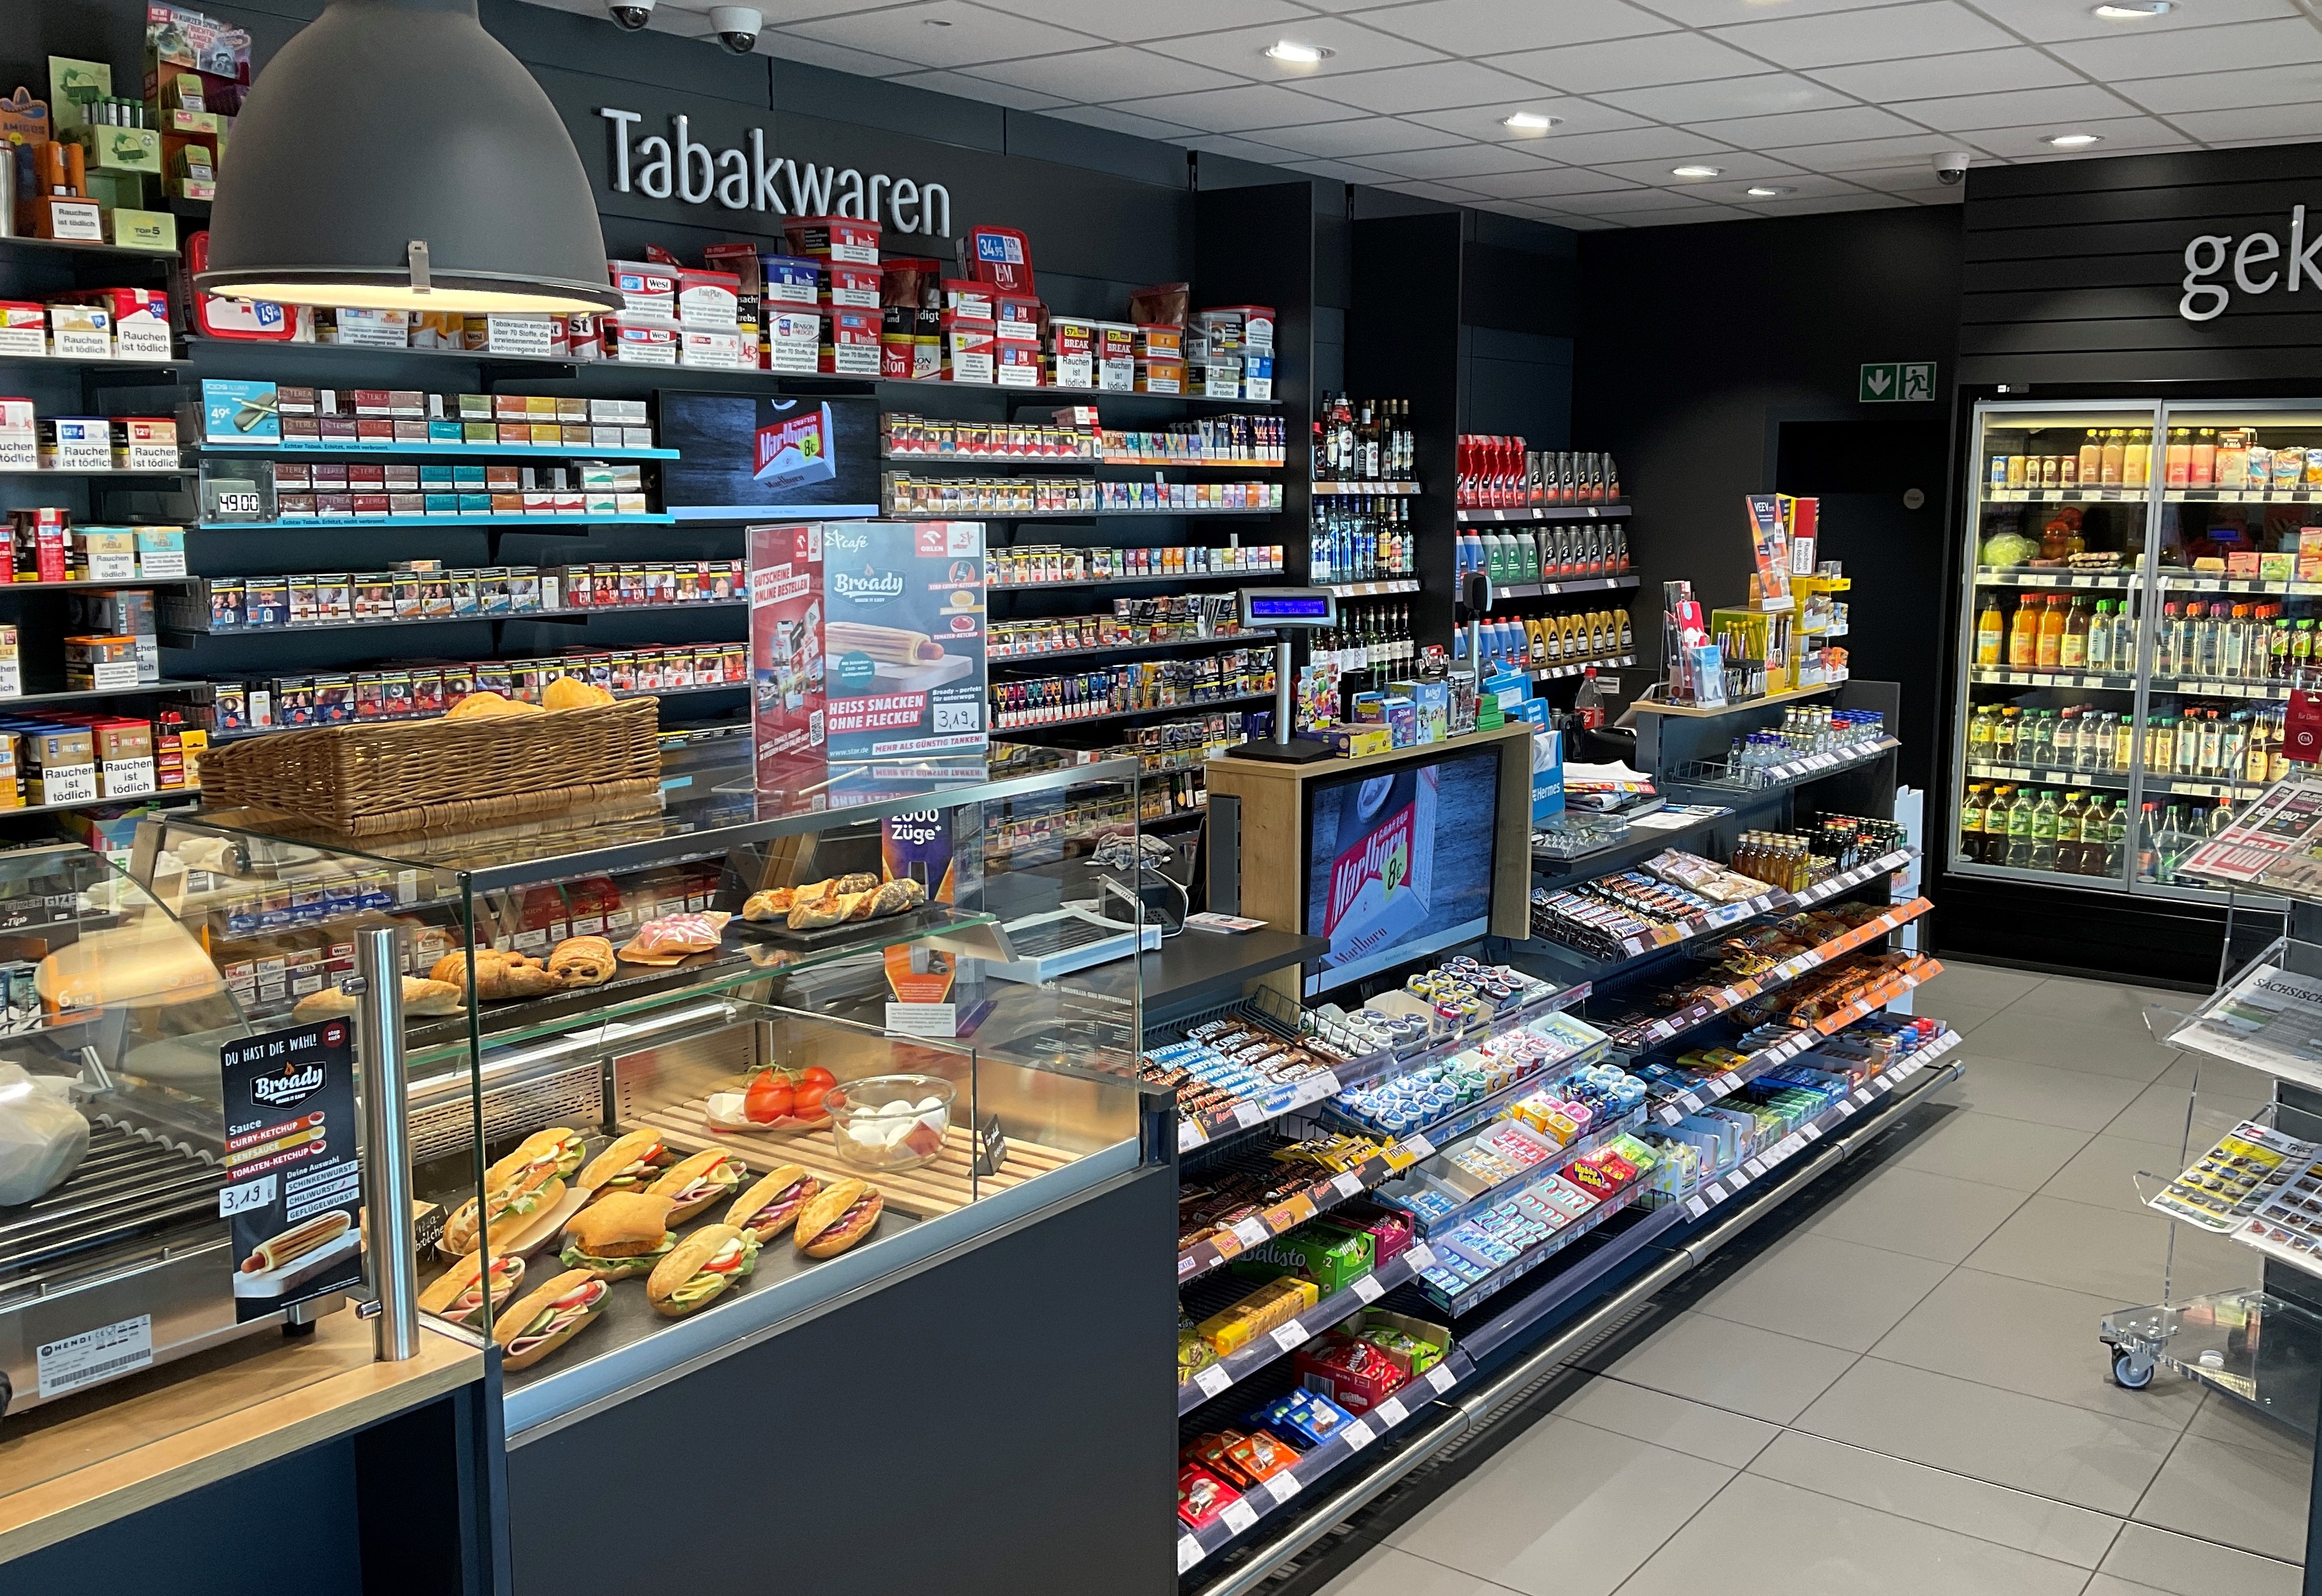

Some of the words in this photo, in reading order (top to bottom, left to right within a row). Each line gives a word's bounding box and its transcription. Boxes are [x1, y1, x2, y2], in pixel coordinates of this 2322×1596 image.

[600, 107, 950, 238] Tabakwaren
[58, 208, 93, 218] Rauchen
[69, 218, 96, 228] tödlich
[134, 227, 151, 235] TOP
[152, 227, 160, 235] 5
[2179, 205, 2322, 321] gek
[649, 279, 669, 289] West
[491, 320, 528, 329] Tabakrauch
[793, 322, 814, 330] BENSON
[63, 336, 103, 345] Rauchen
[123, 331, 166, 341] Rauchen
[651, 331, 669, 340] West
[854, 333, 877, 345] Winston
[63, 345, 74, 353] ist
[76, 345, 105, 354] tödlich
[121, 343, 133, 352] ist
[136, 343, 169, 353] tödlich
[1064, 338, 1089, 350] BREAK
[1107, 343, 1131, 353] BREAK
[882, 360, 905, 373] ston
[1072, 368, 1080, 376] ist
[1065, 378, 1086, 388] tödlich
[1107, 381, 1128, 392] tödlich
[289, 390, 312, 398] TEREA
[760, 422, 818, 466] Marlboro
[65, 447, 110, 456] Rauchen
[135, 447, 176, 457] Rauchen
[62, 458, 75, 467] ist
[77, 458, 111, 467] tödlich
[133, 459, 145, 468] ist
[147, 458, 178, 468] tödlich
[220, 494, 258, 511] 49.00
[1755, 502, 1768, 512] VEEV
[842, 535, 869, 553] café
[1803, 541, 1811, 570] Rauchen
[101, 569, 127, 578] tödlich
[754, 568, 790, 587] GUTSCHEINE
[834, 572, 903, 595] Broady
[755, 586, 776, 603] ONLINE
[778, 578, 808, 597] BESTELLEN
[136, 644, 157, 652] chen
[943, 693, 975, 701] unterwegs
[829, 700, 865, 715] HEISS
[867, 695, 924, 711] SNACKEN
[829, 715, 863, 730] OHNE
[865, 710, 919, 727] FLECKEN
[875, 744, 898, 753] MEHR
[899, 742, 915, 751] ALS
[915, 738, 948, 749] GÜNSTIG
[951, 735, 983, 745] TANKEN!
[829, 747, 869, 756] www.star.de
[105, 760, 153, 772] Rauchen
[46, 767, 94, 779] Rauchen
[124, 772, 138, 781] ist
[65, 779, 79, 788] ist
[113, 782, 150, 793] tödlich
[53, 789, 91, 801] tödlich
[1537, 781, 1561, 801] Hermes
[2276, 810, 2300, 822] 180
[1330, 826, 1407, 929] Marlboro
[1387, 857, 1403, 891] 8€
[5, 897, 43, 912] GIZEH
[44, 894, 77, 907] GIZE
[333, 946, 351, 954] West
[1334, 927, 1387, 964] Marlboro
[58, 989, 70, 1006] 6
[1186, 1019, 1228, 1039] CORNY
[1210, 1030, 1251, 1051] CORNY
[225, 1051, 239, 1067] DU
[242, 1045, 265, 1062] HAST
[269, 1041, 286, 1055] DIE
[289, 1033, 317, 1052] WAHL!
[1143, 1040, 1187, 1059] BOUNTY
[1162, 1048, 1205, 1067] BOUNTY
[1271, 1062, 1310, 1084] CORNY
[255, 1065, 323, 1097] Broady
[1265, 1090, 1292, 1107] BOUNTY
[1216, 1108, 1233, 1124] Mars
[229, 1118, 262, 1136] Sauce
[230, 1121, 298, 1149] CURRY-KETCHUP
[231, 1142, 280, 1163] SENFSAUCE
[2287, 1143, 2316, 1155] TRUCK
[231, 1147, 309, 1179] TOMATEN-KETCHUP
[286, 1166, 308, 1180] Deine
[308, 1156, 340, 1173] Auswahl
[1574, 1161, 1598, 1177] Hubba
[1578, 1173, 1602, 1189] Bubba
[1313, 1181, 1332, 1199] Mars
[223, 1184, 261, 1210] 3,19
[55, 1335, 91, 1352] HENDI
